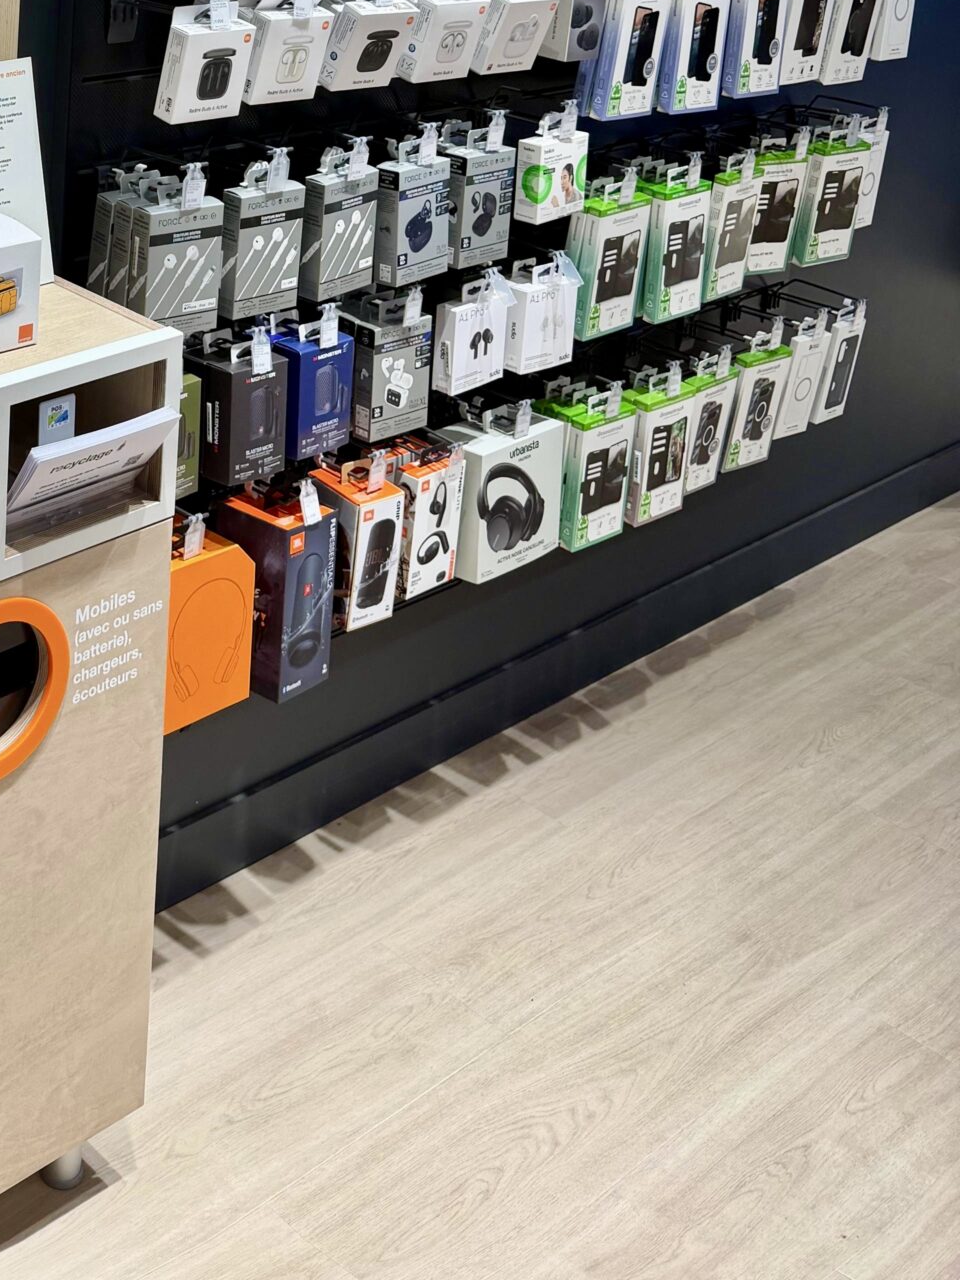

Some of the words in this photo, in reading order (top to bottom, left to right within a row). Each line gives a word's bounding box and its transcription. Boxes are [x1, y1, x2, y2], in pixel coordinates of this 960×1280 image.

[509, 440, 540, 459] urbanista
[74, 622, 110, 647] (avec
[113, 613, 130, 628] ou
[133, 600, 163, 620] sans
[75, 590, 136, 624] Mobiles
[74, 630, 132, 664] batterie),
[73, 648, 143, 685] chargeurs,
[72, 667, 138, 704] écouteurs
